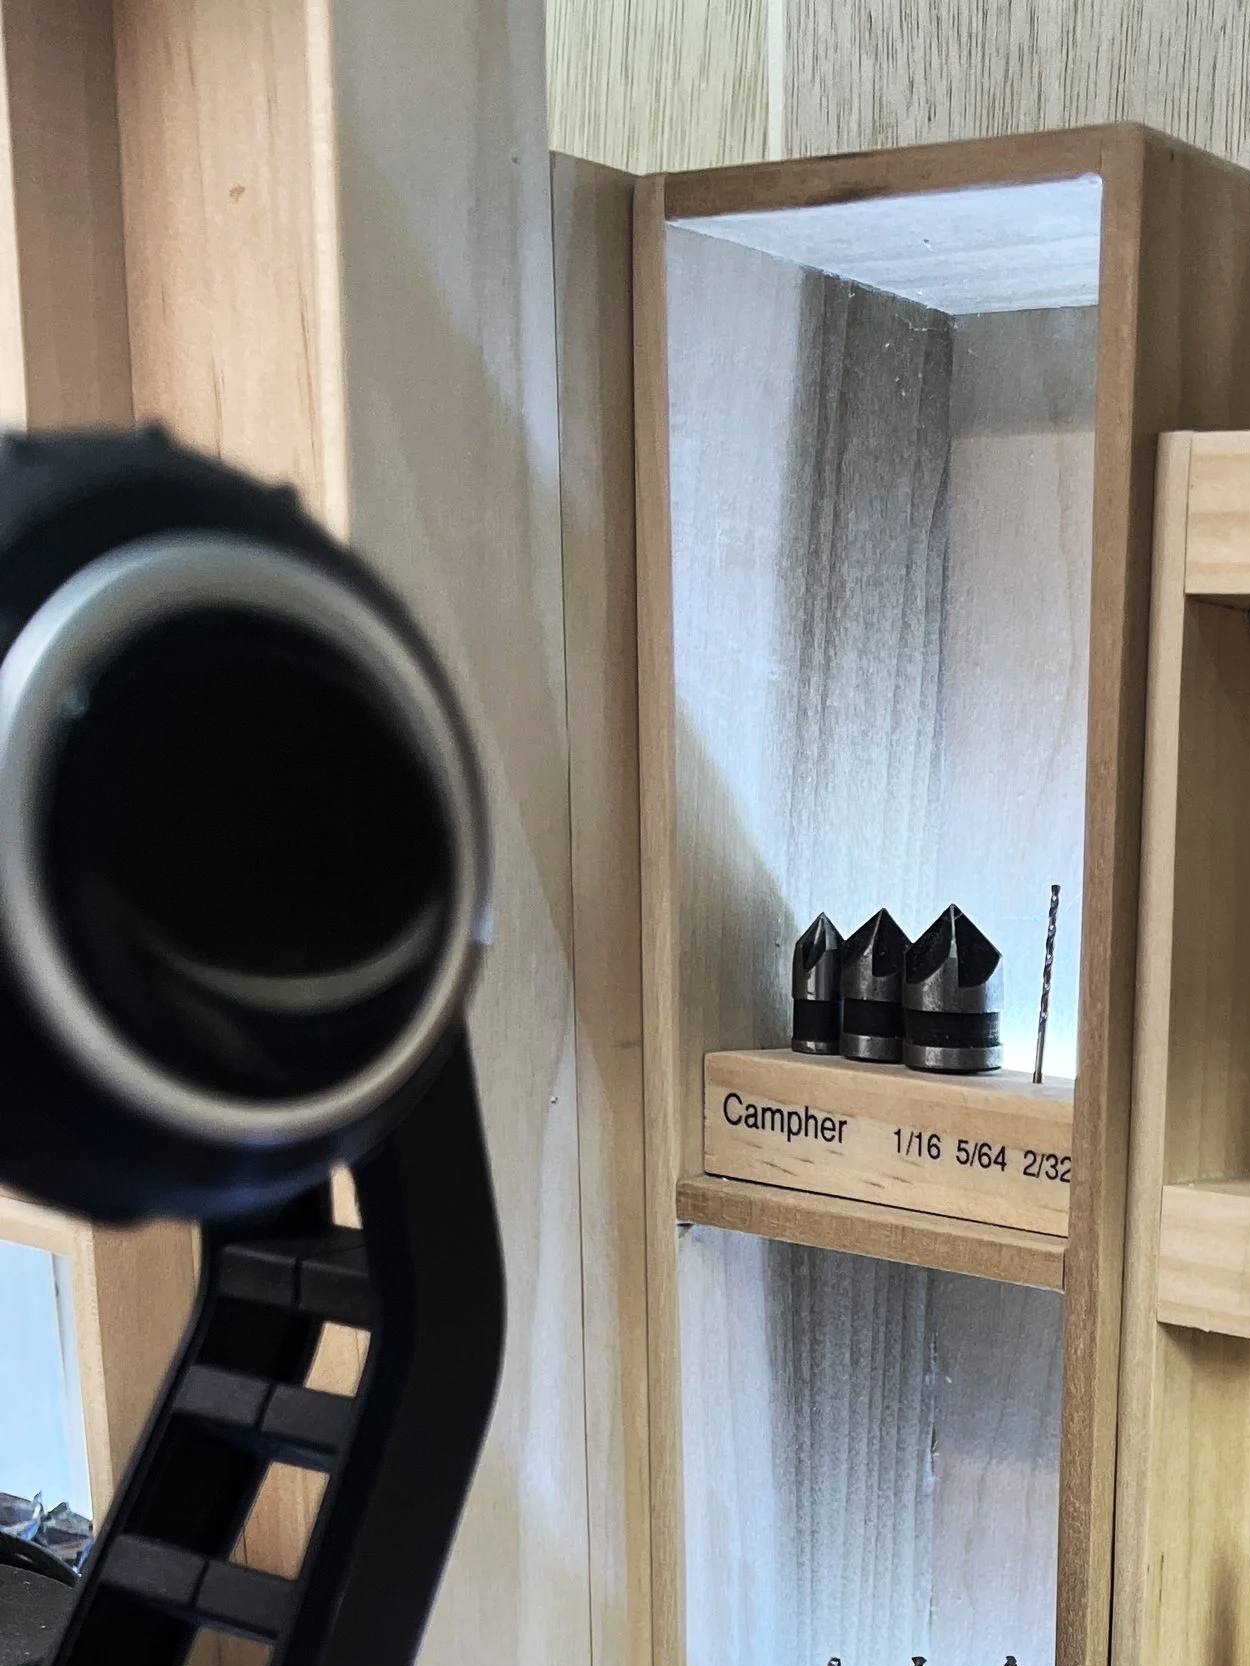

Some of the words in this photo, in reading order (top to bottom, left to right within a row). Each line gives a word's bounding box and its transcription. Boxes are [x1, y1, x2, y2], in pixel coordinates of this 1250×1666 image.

[723, 1092, 848, 1143] Campher
[893, 1128, 942, 1160] 1/16
[956, 1140, 1008, 1172] 5/64
